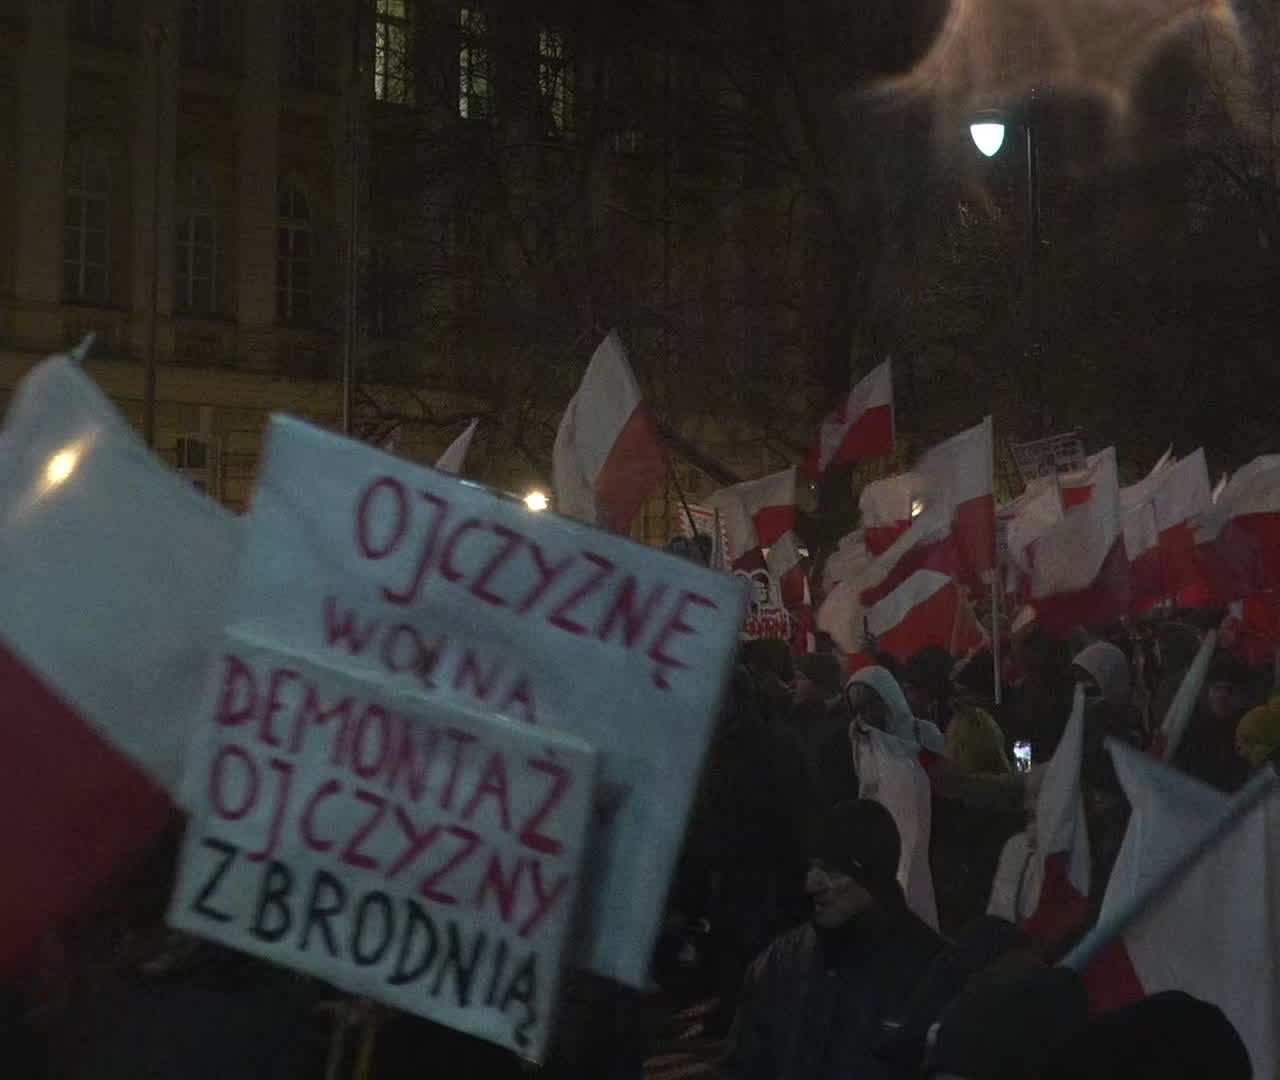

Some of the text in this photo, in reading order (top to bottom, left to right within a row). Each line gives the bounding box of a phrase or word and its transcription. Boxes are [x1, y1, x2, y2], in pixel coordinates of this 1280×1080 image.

[354, 477, 718, 690] OJCZYZNĘ
[209, 744, 568, 938] OJCZYZNY
[219, 654, 572, 853] DEMONTAŻ
[192, 837, 543, 1046] ZBRODNIĄ
